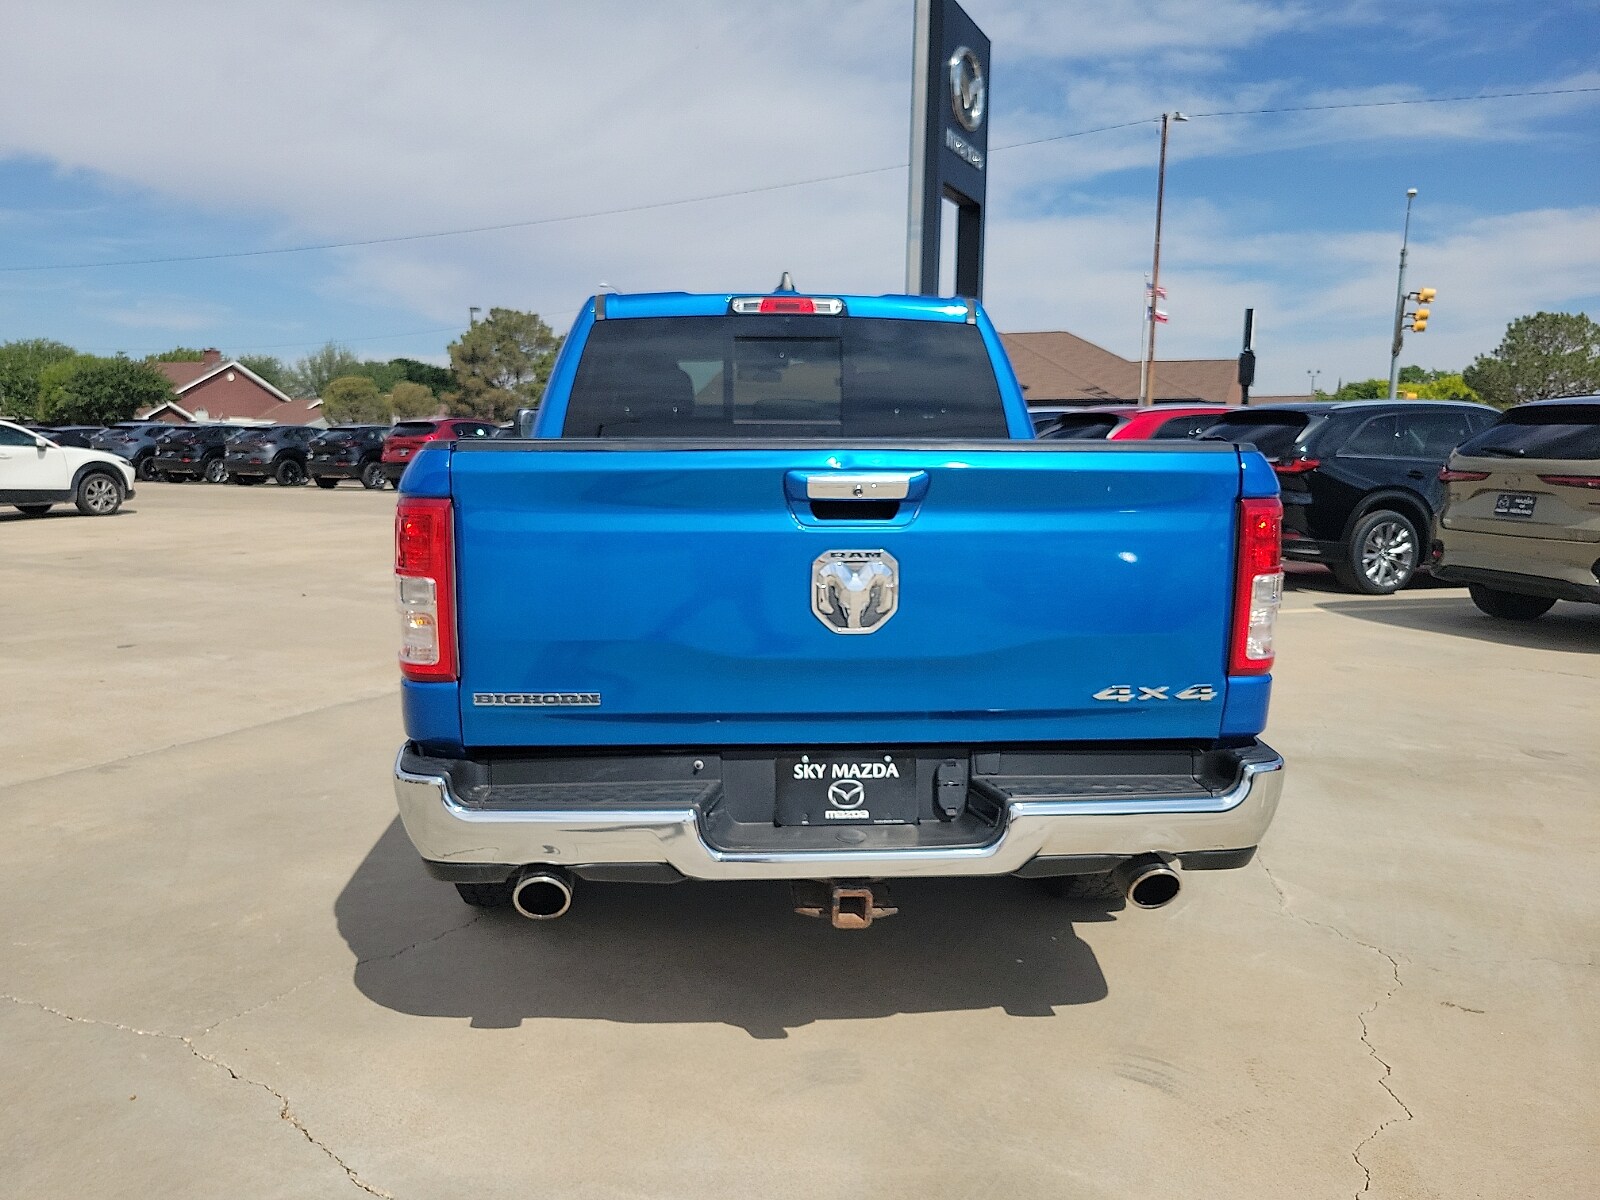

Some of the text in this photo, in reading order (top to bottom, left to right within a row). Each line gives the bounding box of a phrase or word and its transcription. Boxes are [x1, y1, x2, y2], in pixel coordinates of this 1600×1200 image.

[473, 692, 601, 706] BIGHORN
[793, 762, 900, 779] SKY MAZDA
